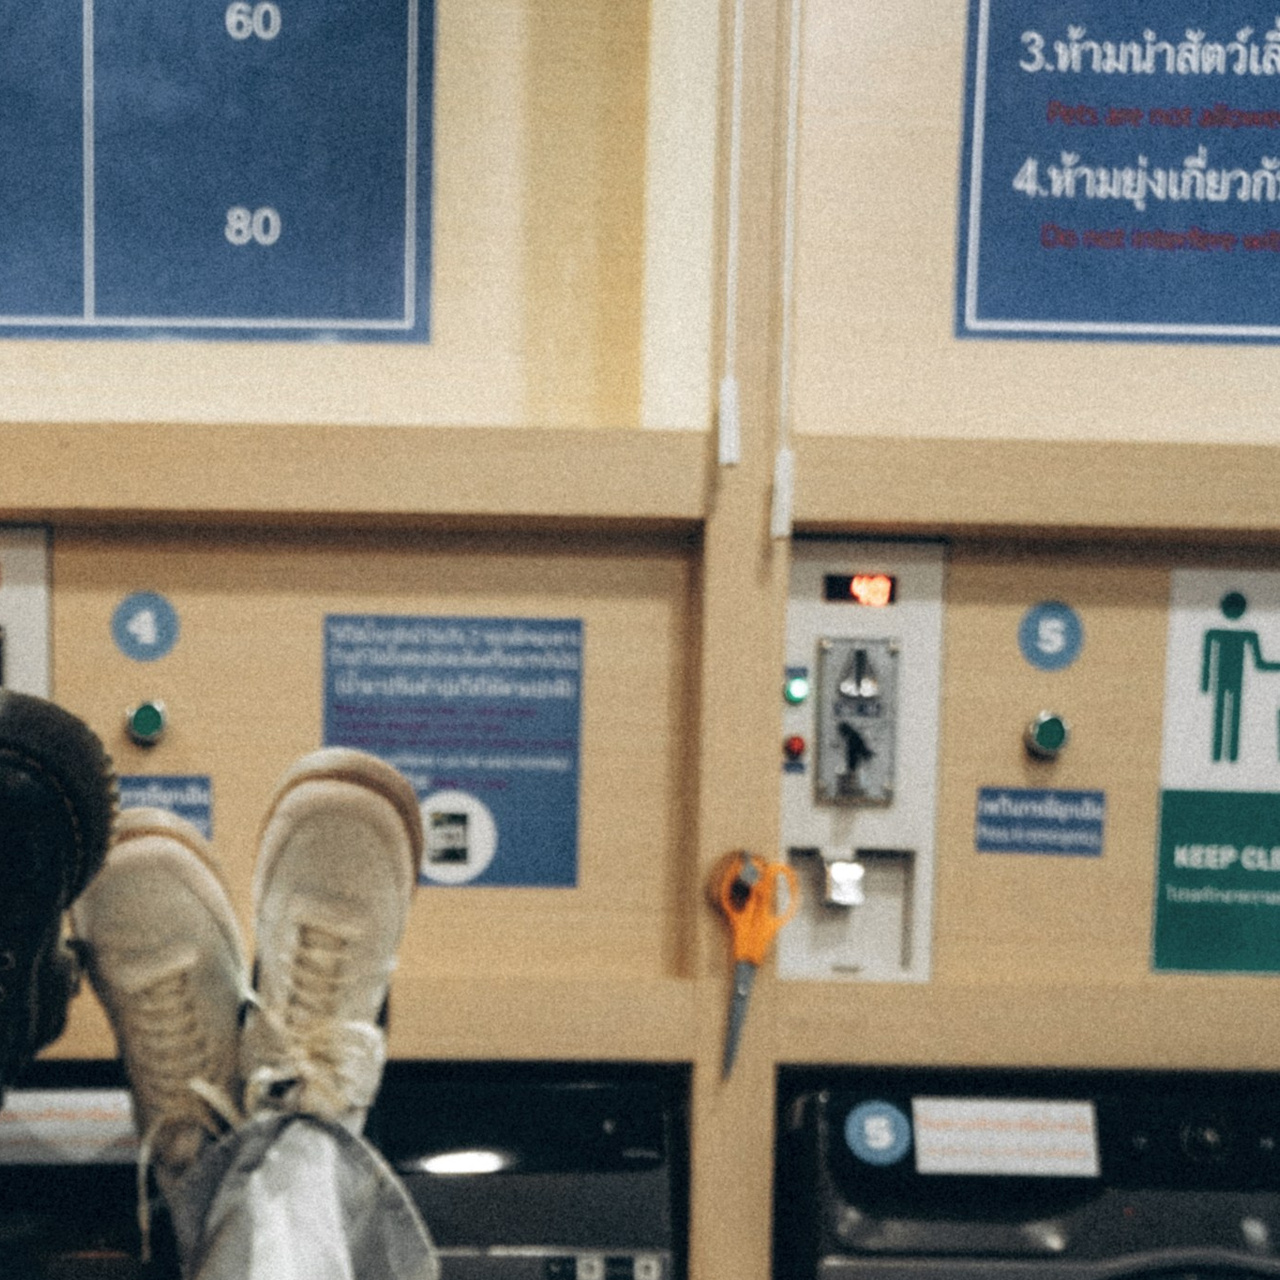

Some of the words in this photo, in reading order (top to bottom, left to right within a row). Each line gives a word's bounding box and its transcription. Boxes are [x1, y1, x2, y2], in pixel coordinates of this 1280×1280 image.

[225, 1, 282, 40] 60
[224, 206, 282, 246] 80
[1173, 843, 1239, 870] KEEP
